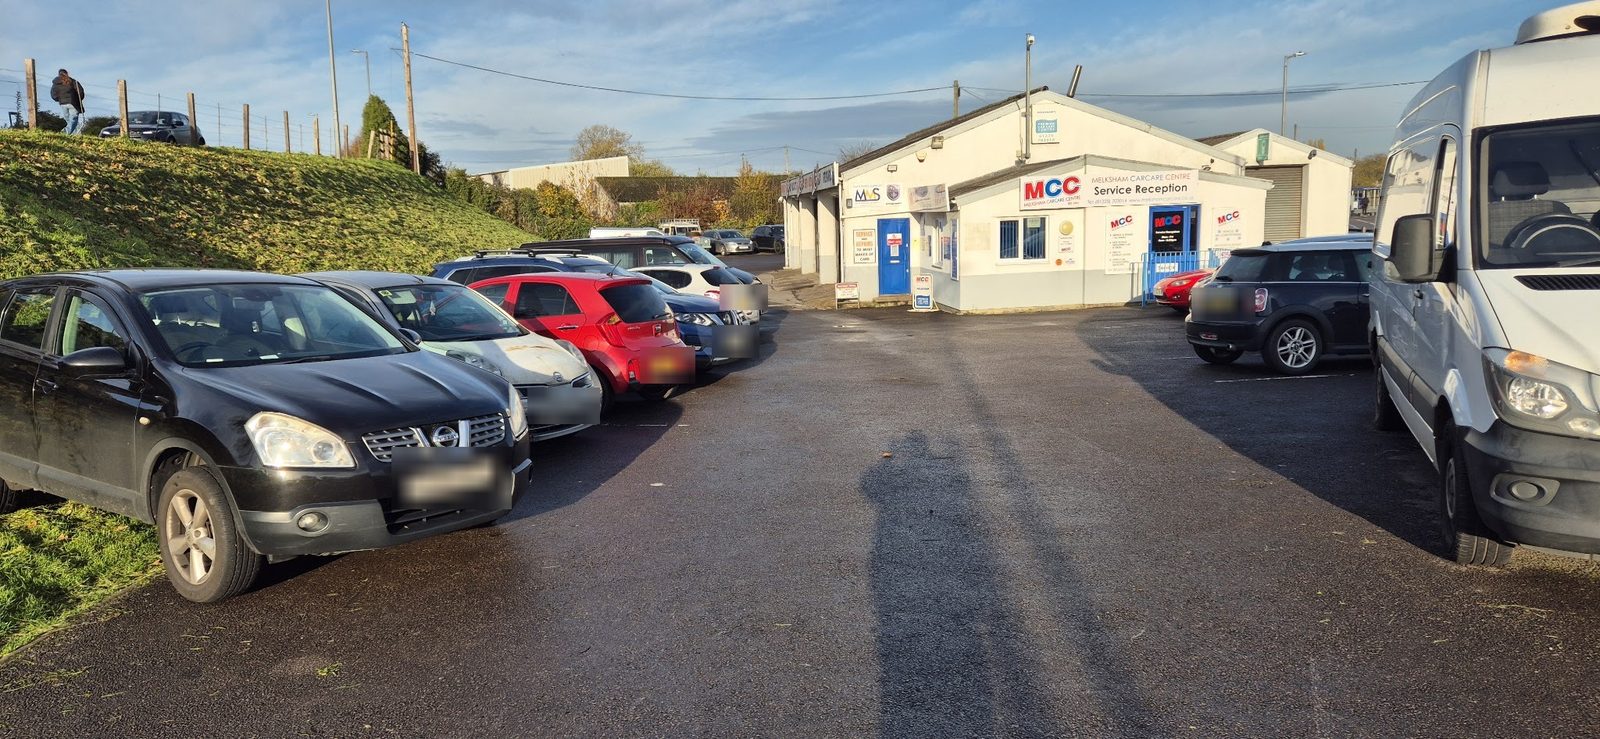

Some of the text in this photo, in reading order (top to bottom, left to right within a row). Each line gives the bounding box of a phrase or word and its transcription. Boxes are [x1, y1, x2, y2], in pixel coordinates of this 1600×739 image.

[1025, 176, 1081, 200] MCC
[1094, 183, 1188, 196] Service Reception
[1110, 215, 1133, 228] MCC
[1154, 214, 1181, 227] MCC
[1218, 211, 1240, 224] MCC
